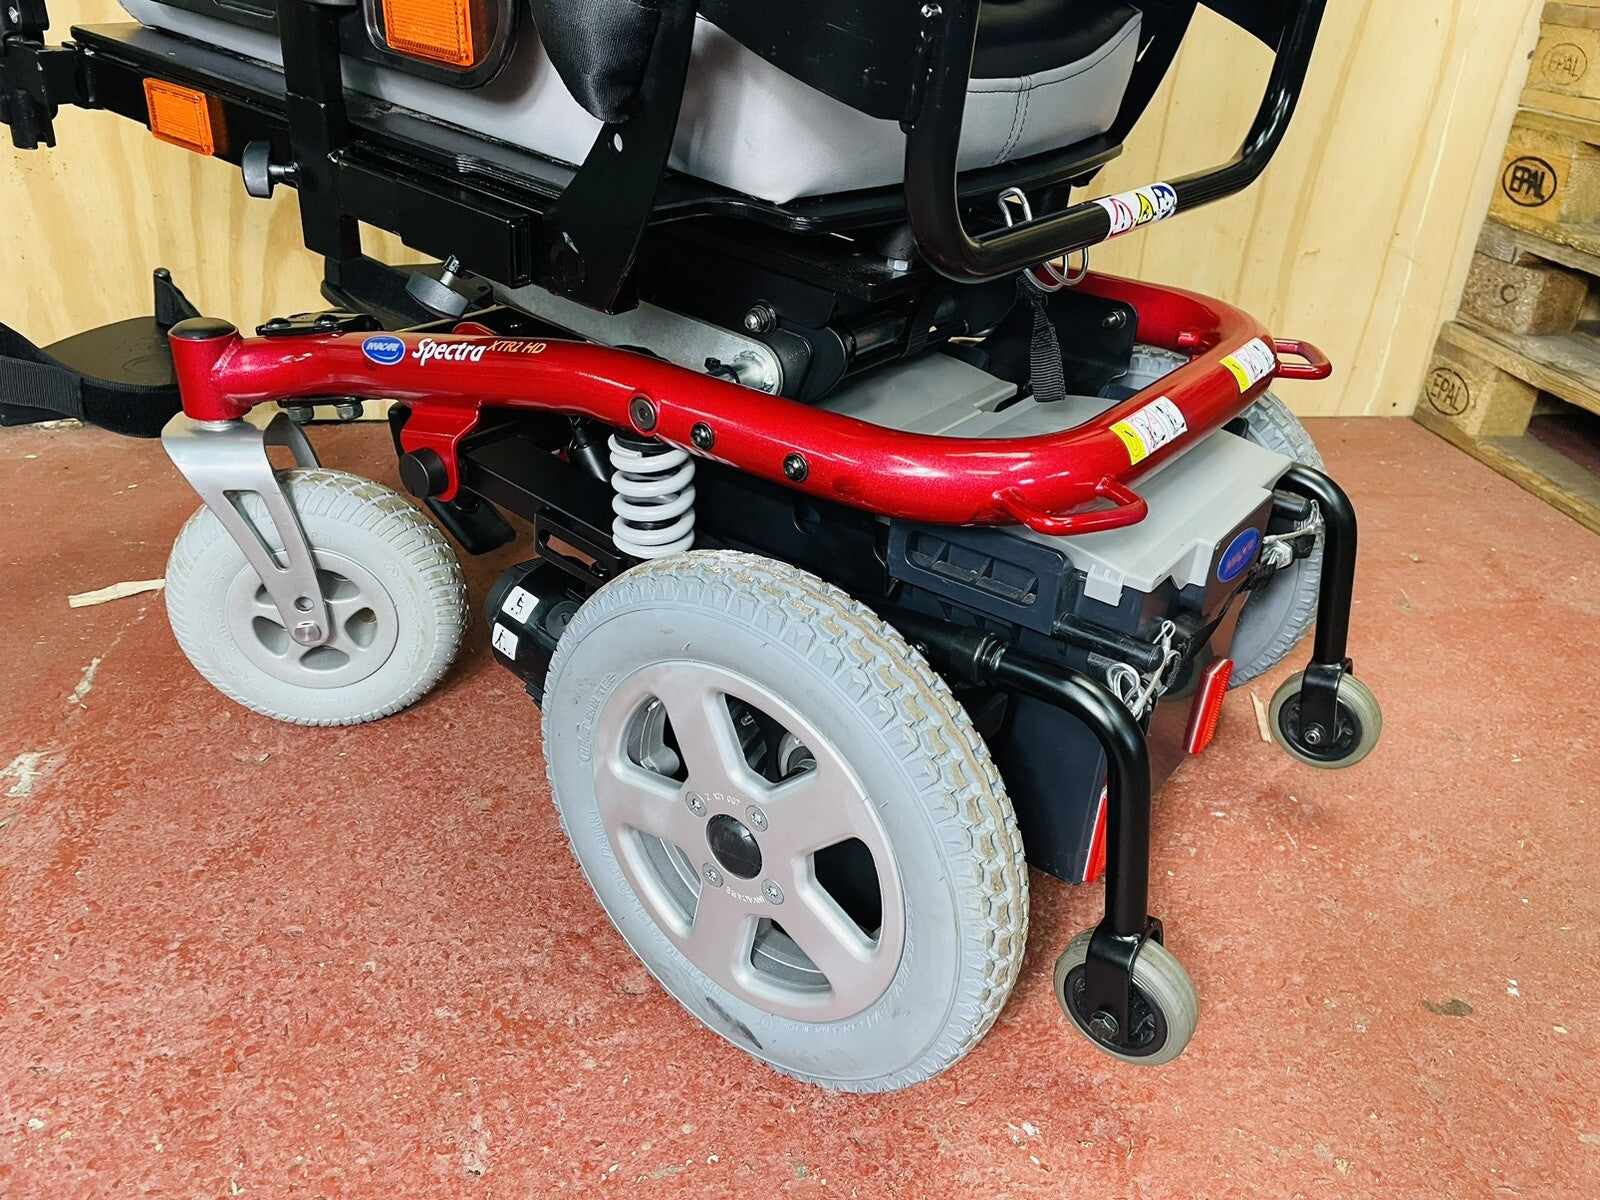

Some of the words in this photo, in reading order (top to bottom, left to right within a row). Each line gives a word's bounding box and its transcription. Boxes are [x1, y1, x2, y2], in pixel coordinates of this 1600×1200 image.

[1509, 165, 1546, 201] EPAL
[412, 338, 486, 366] Spectra
[485, 340, 521, 353] XTR2
[522, 341, 547, 354] HD
[1430, 373, 1461, 411] EPAL
[725, 885, 766, 905] INVACARE
